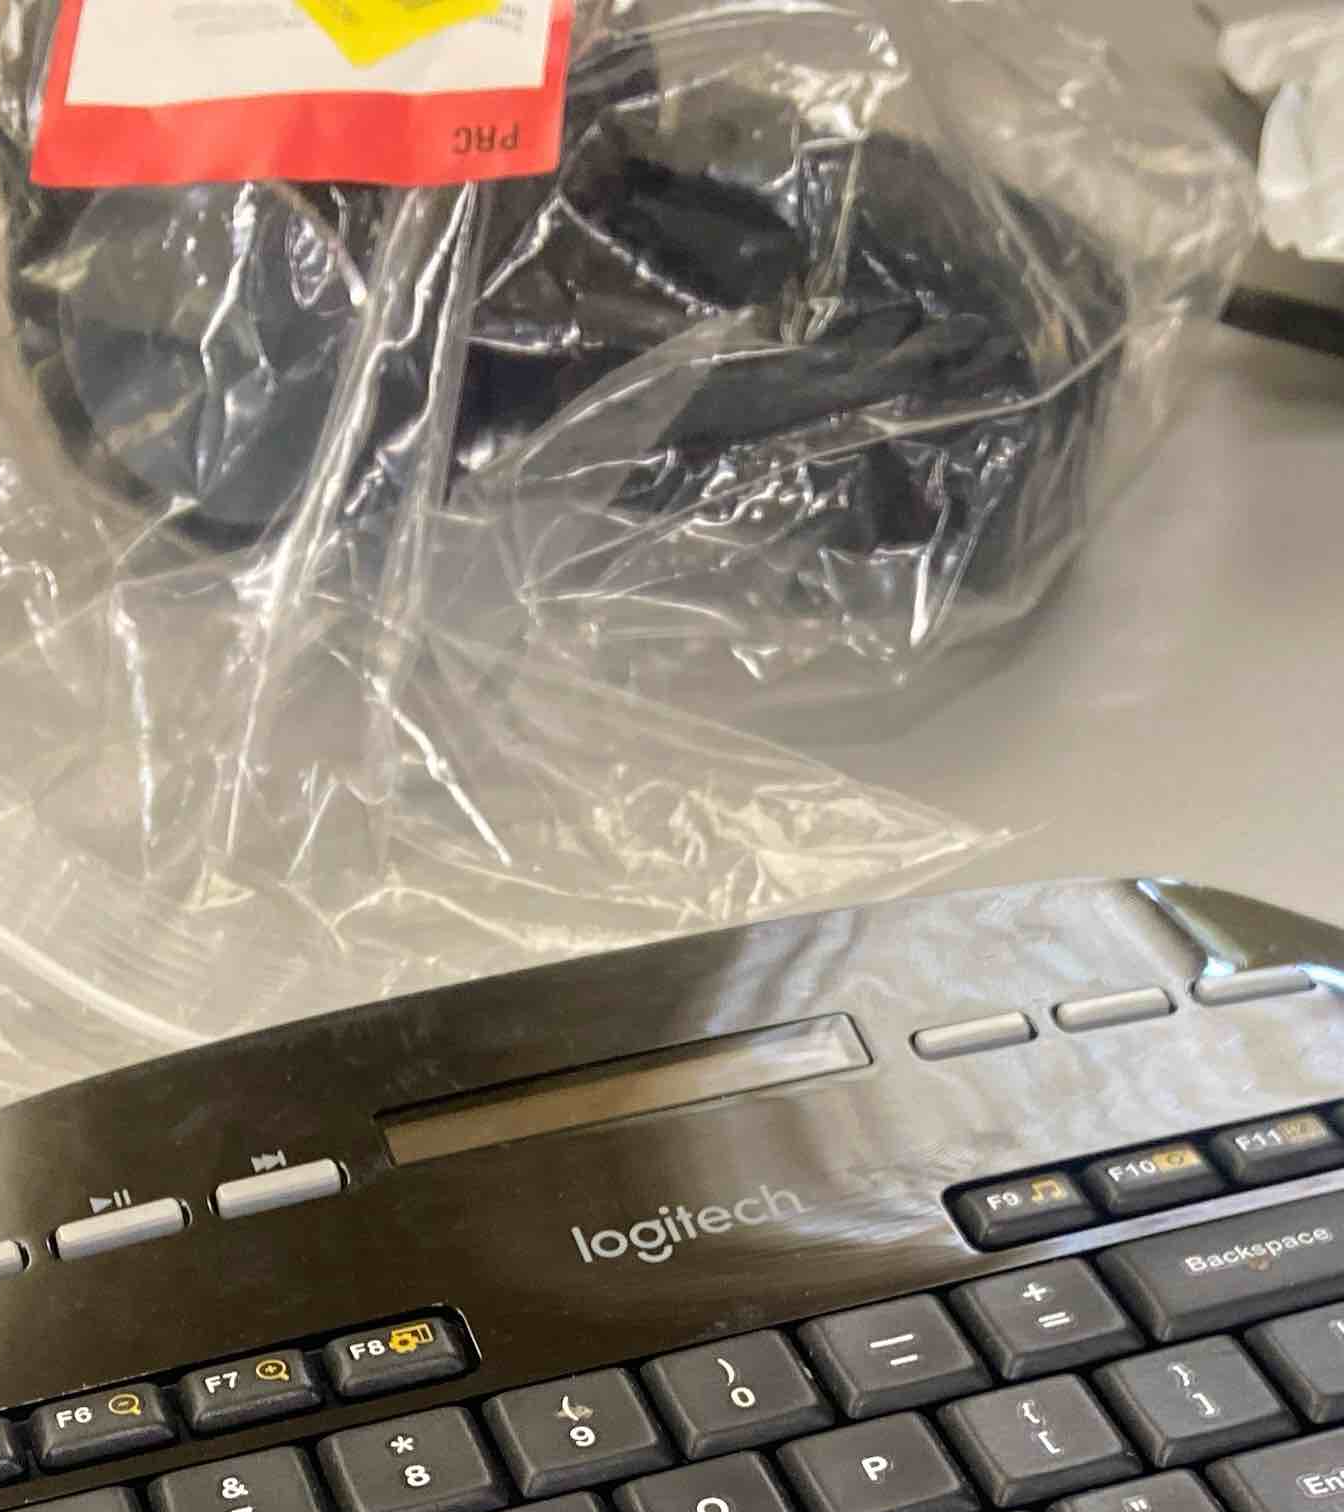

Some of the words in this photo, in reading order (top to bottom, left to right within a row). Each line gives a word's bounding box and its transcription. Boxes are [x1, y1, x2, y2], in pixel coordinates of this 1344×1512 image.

[1235, 1129, 1282, 1153] F11
[1108, 1159, 1156, 1184] F10
[986, 1191, 1023, 1211] F9
[571, 1182, 808, 1266] logitech
[1184, 1227, 1333, 1273] Backspace
[349, 1339, 386, 1361] F8
[204, 1371, 238, 1394] F7
[730, 1386, 756, 1408] 0
[55, 1406, 93, 1429] F6
[569, 1426, 596, 1447] 9
[404, 1464, 431, 1487] 8
[861, 1455, 889, 1481] P
